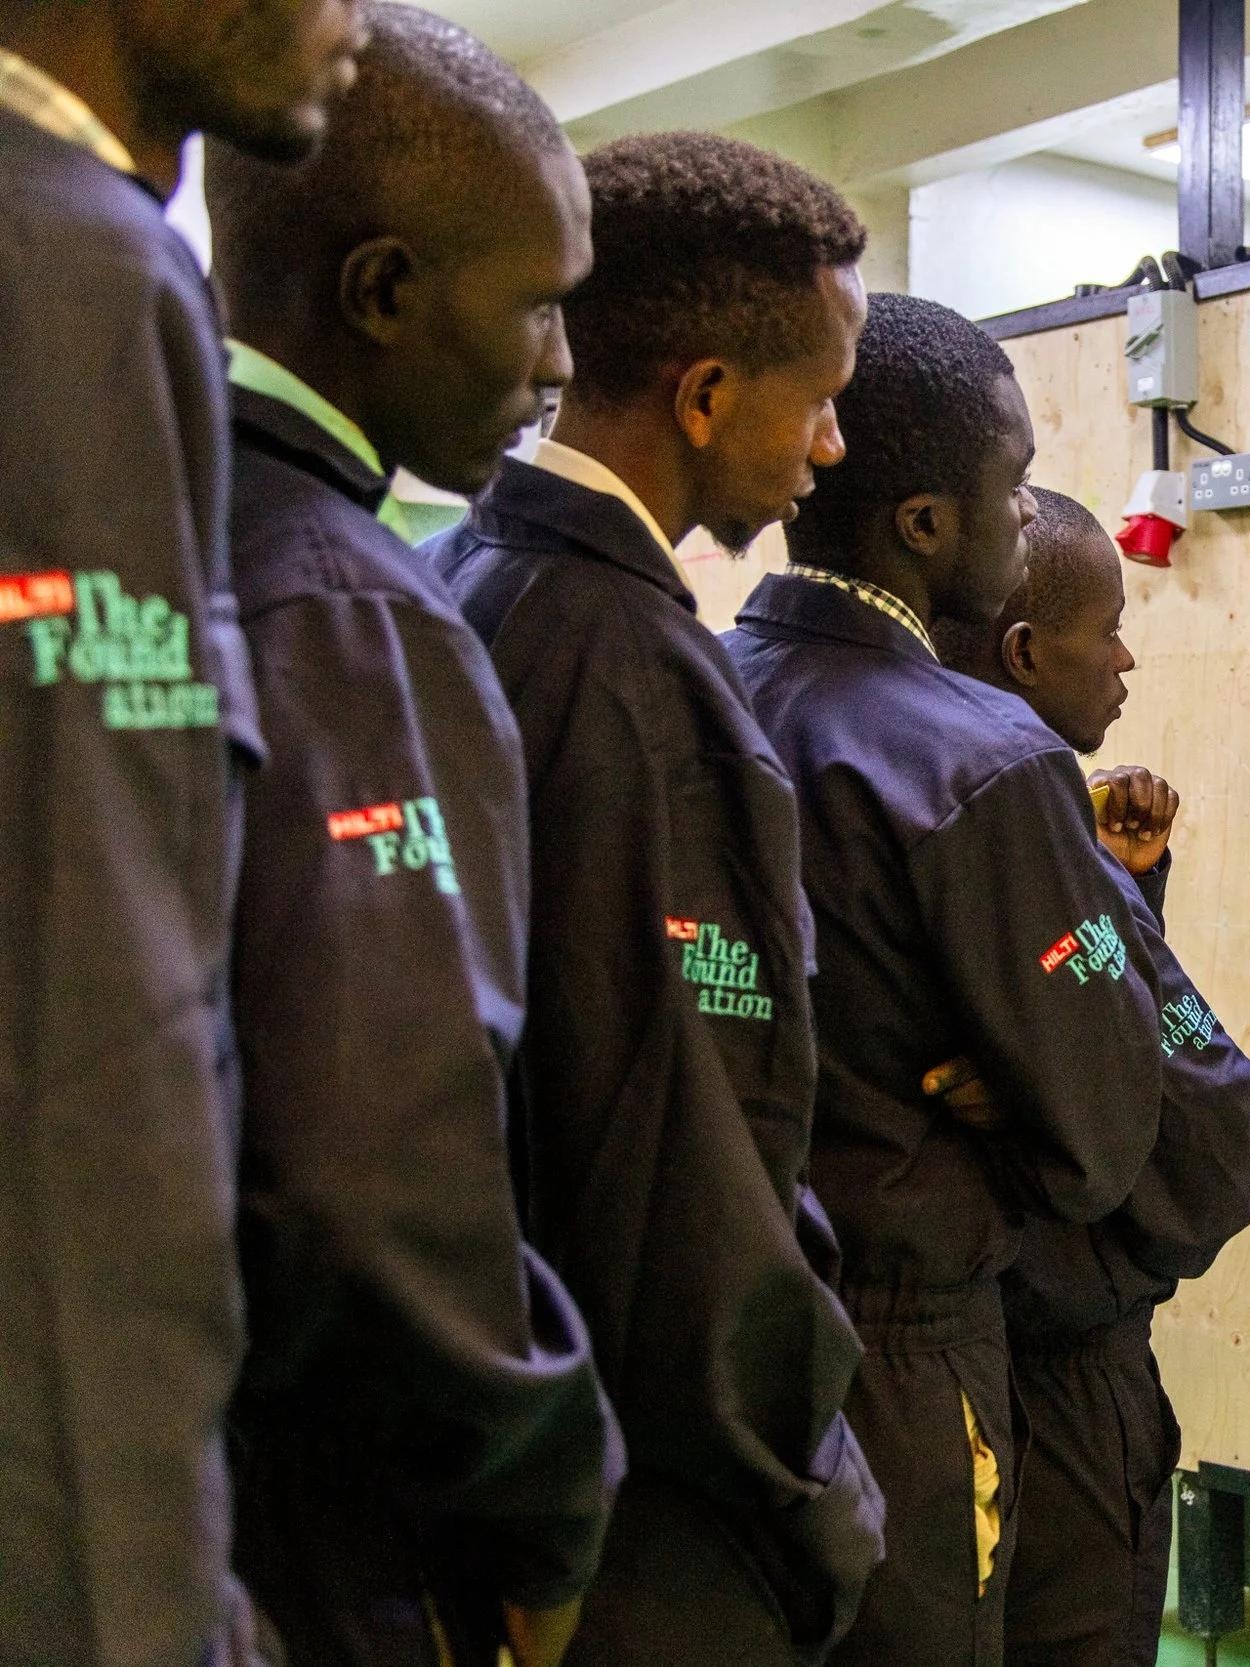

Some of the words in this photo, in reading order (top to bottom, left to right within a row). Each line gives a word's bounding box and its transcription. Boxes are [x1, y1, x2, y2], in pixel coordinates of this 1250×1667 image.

[696, 922, 750, 965] The
[1040, 932, 1080, 974] HILTI
[698, 986, 774, 1021] ation
[1161, 994, 1193, 1032] The
